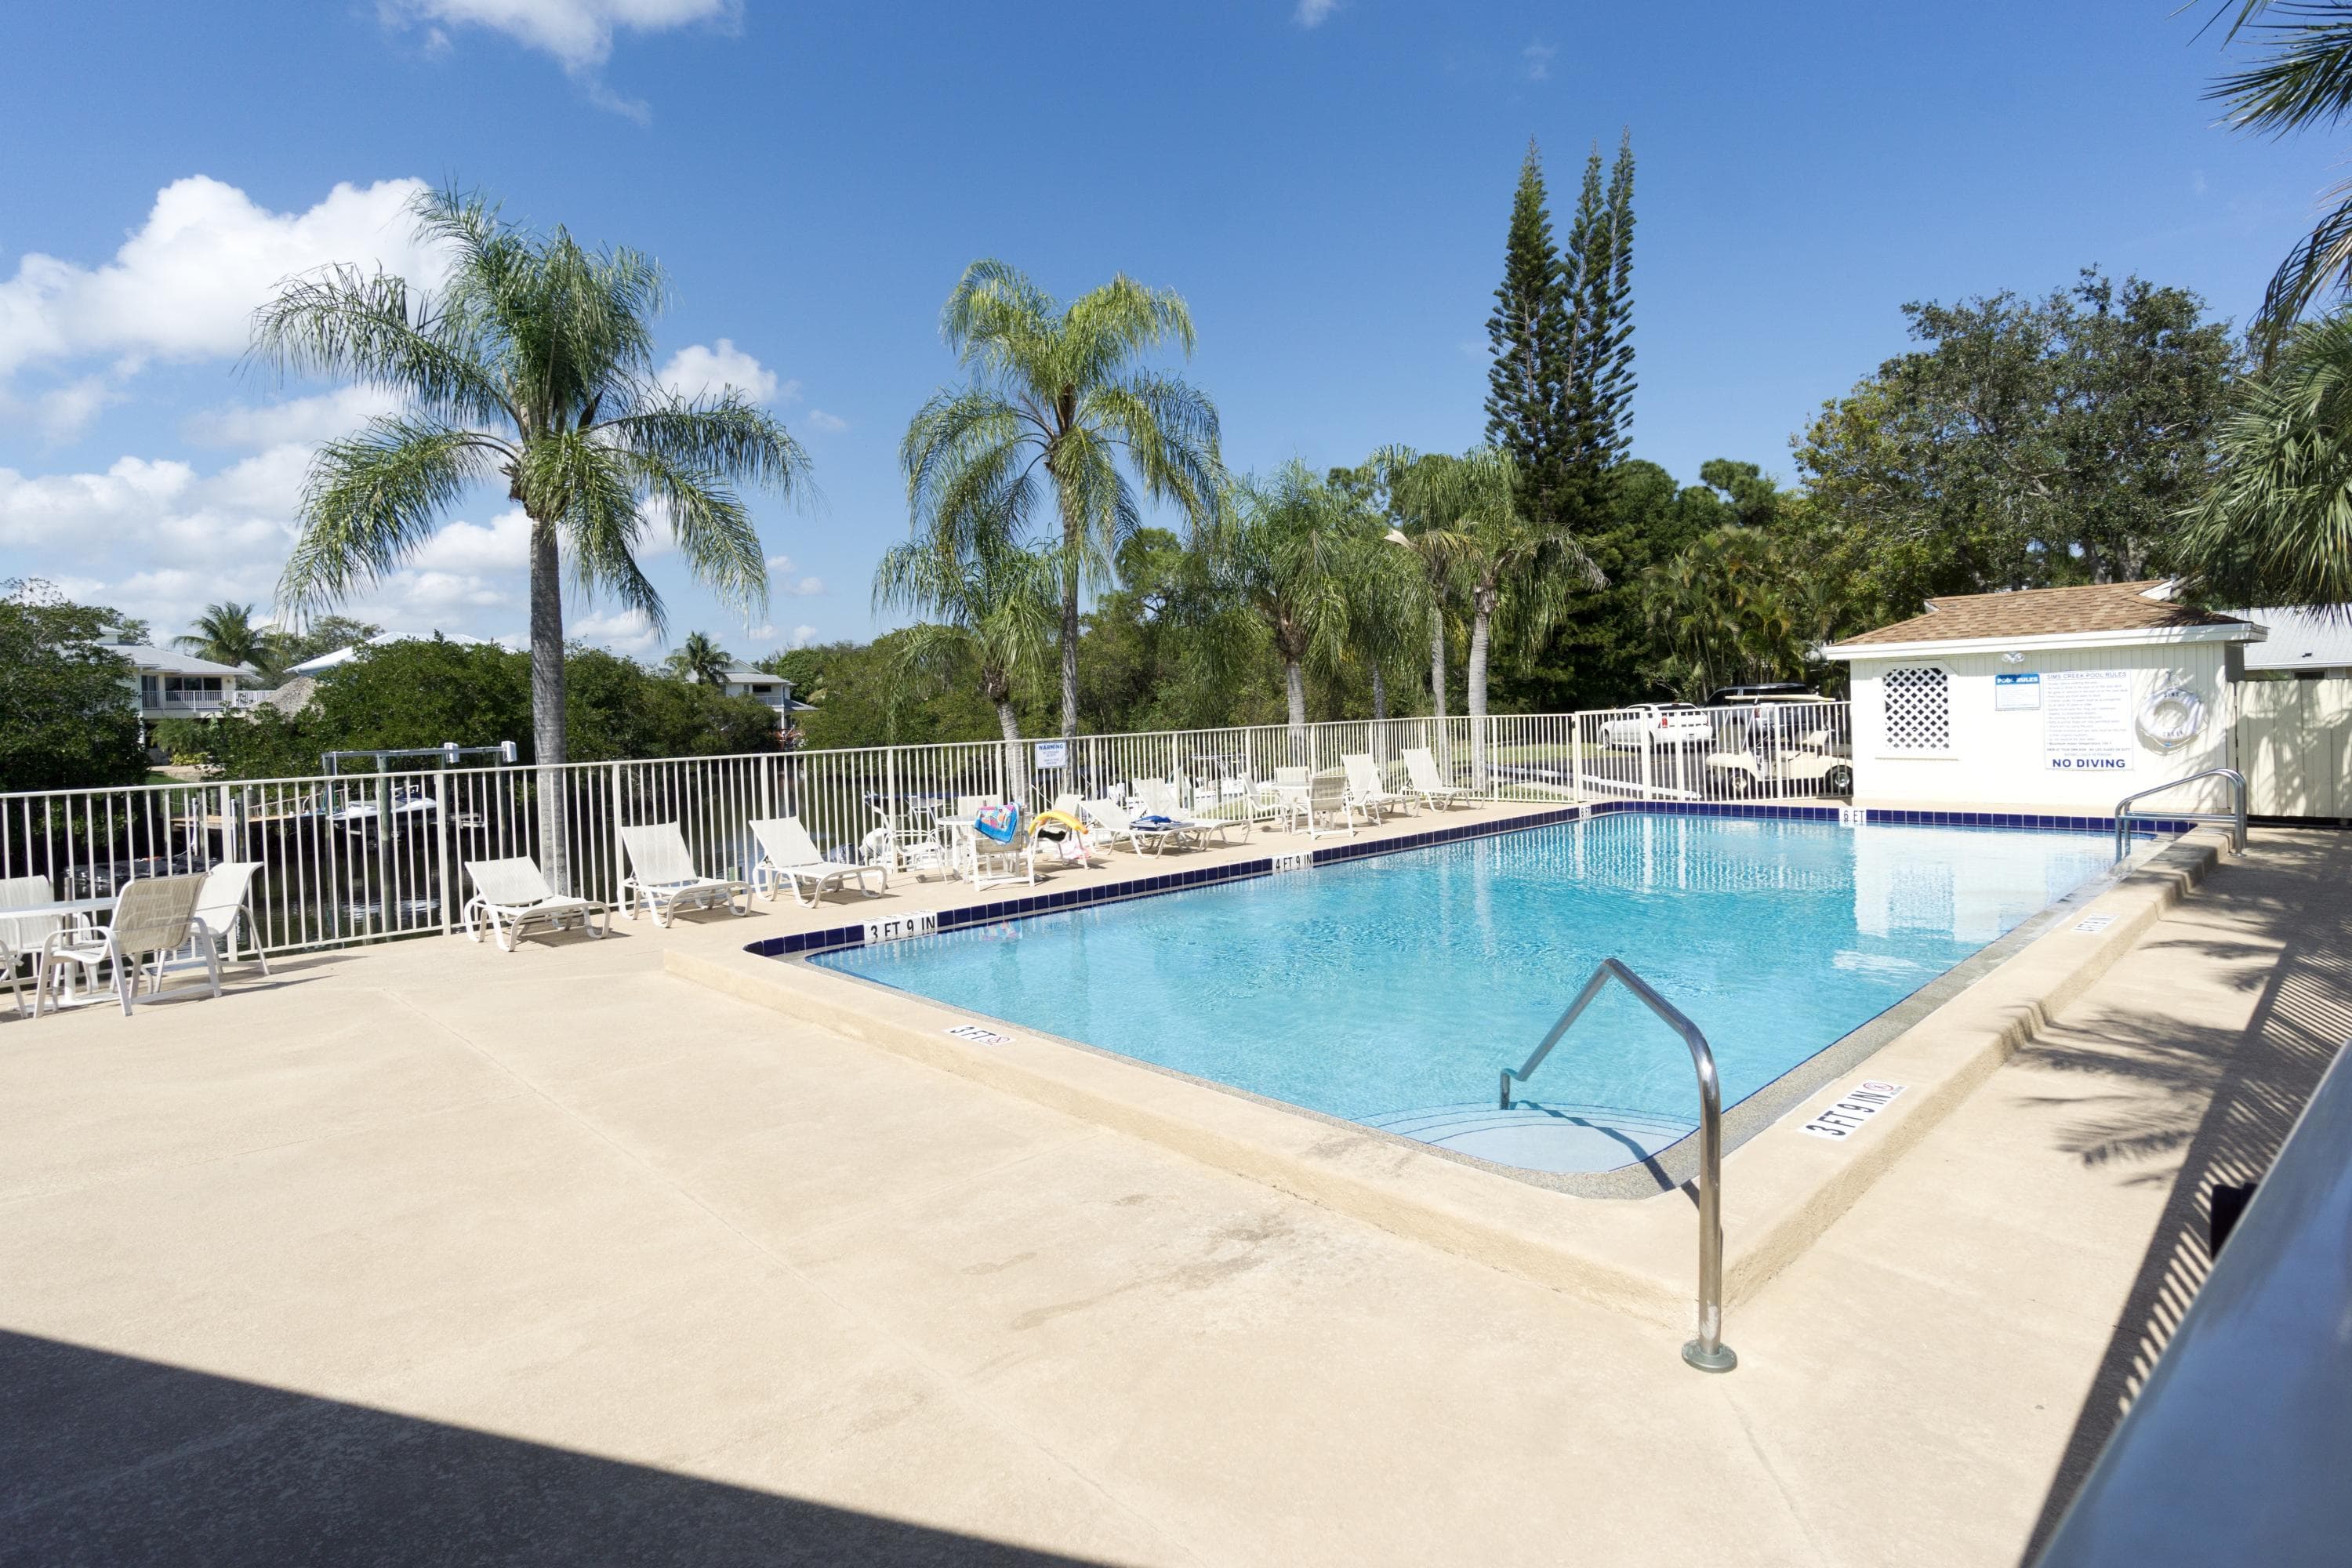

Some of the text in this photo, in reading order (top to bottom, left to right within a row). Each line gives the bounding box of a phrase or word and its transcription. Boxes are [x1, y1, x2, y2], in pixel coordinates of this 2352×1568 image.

[2053, 759, 2125, 768] NO DIVING
[1276, 853, 1312, 869] 4 FT 9 IN
[870, 916, 935, 941] 3 FT 9 IN
[960, 1030, 996, 1040] FT
[1806, 1091, 1892, 1136] 3 FT 9 IN
